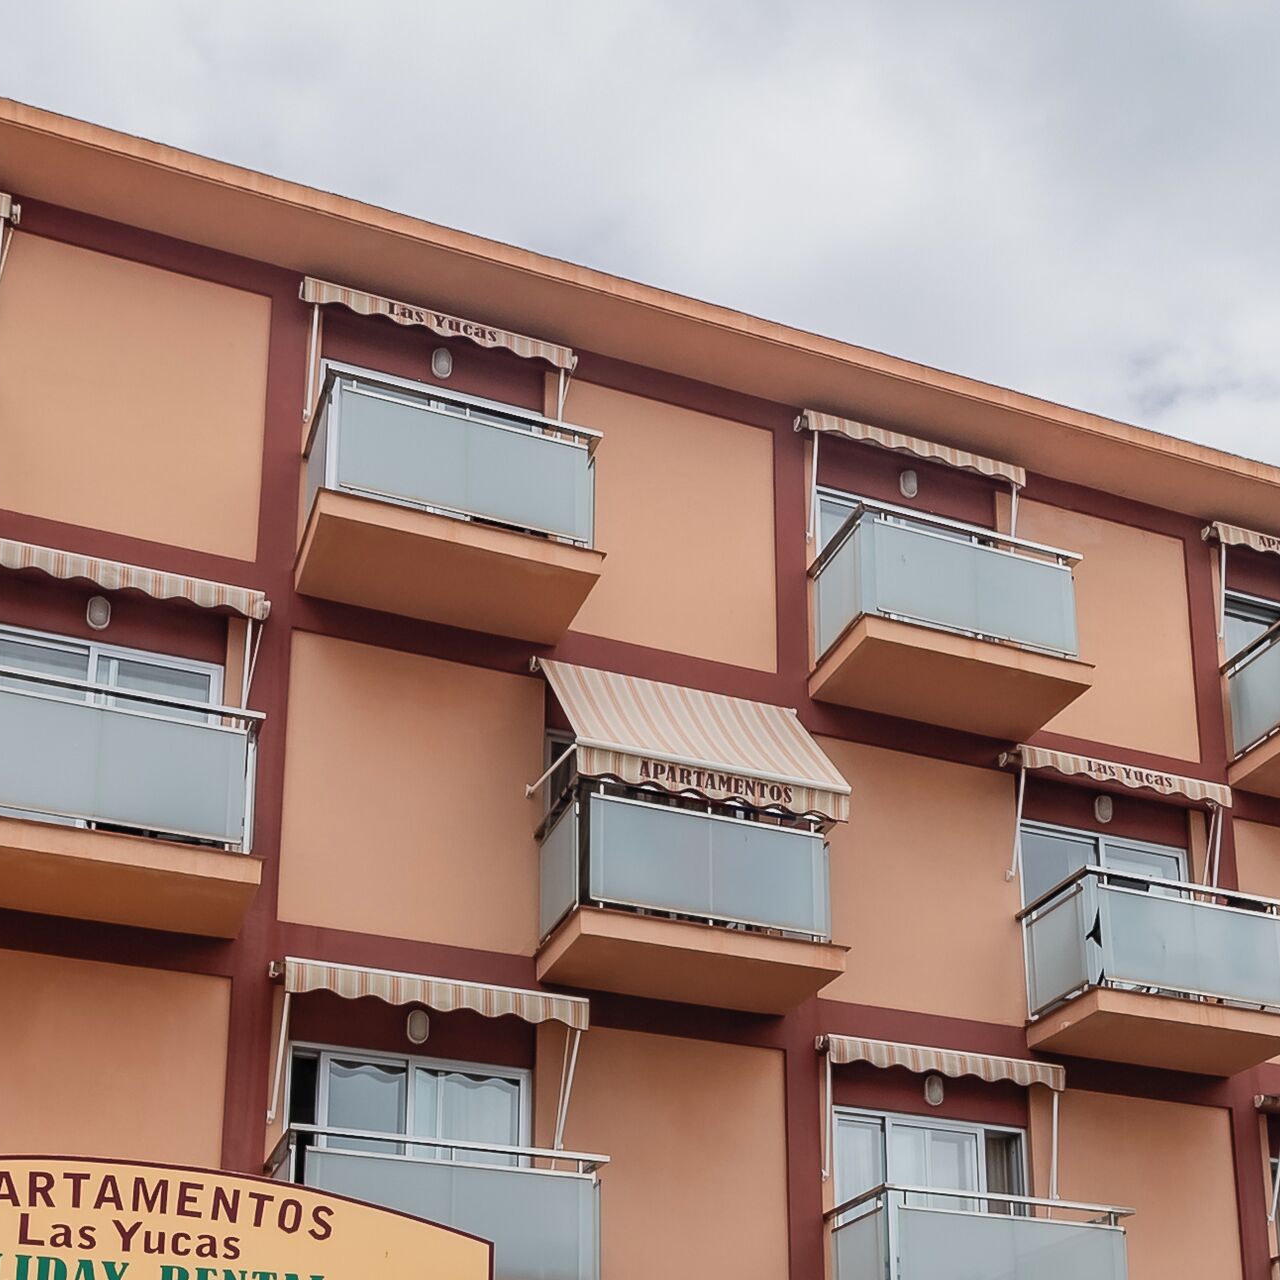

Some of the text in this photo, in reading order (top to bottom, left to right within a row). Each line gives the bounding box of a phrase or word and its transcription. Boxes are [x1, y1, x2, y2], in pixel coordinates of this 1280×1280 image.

[388, 302, 497, 342] Las Yucas
[639, 760, 792, 804] APARTAMENTOS
[1087, 760, 1173, 788] Las Yucas
[17, 1213, 241, 1260] Las Yucas
